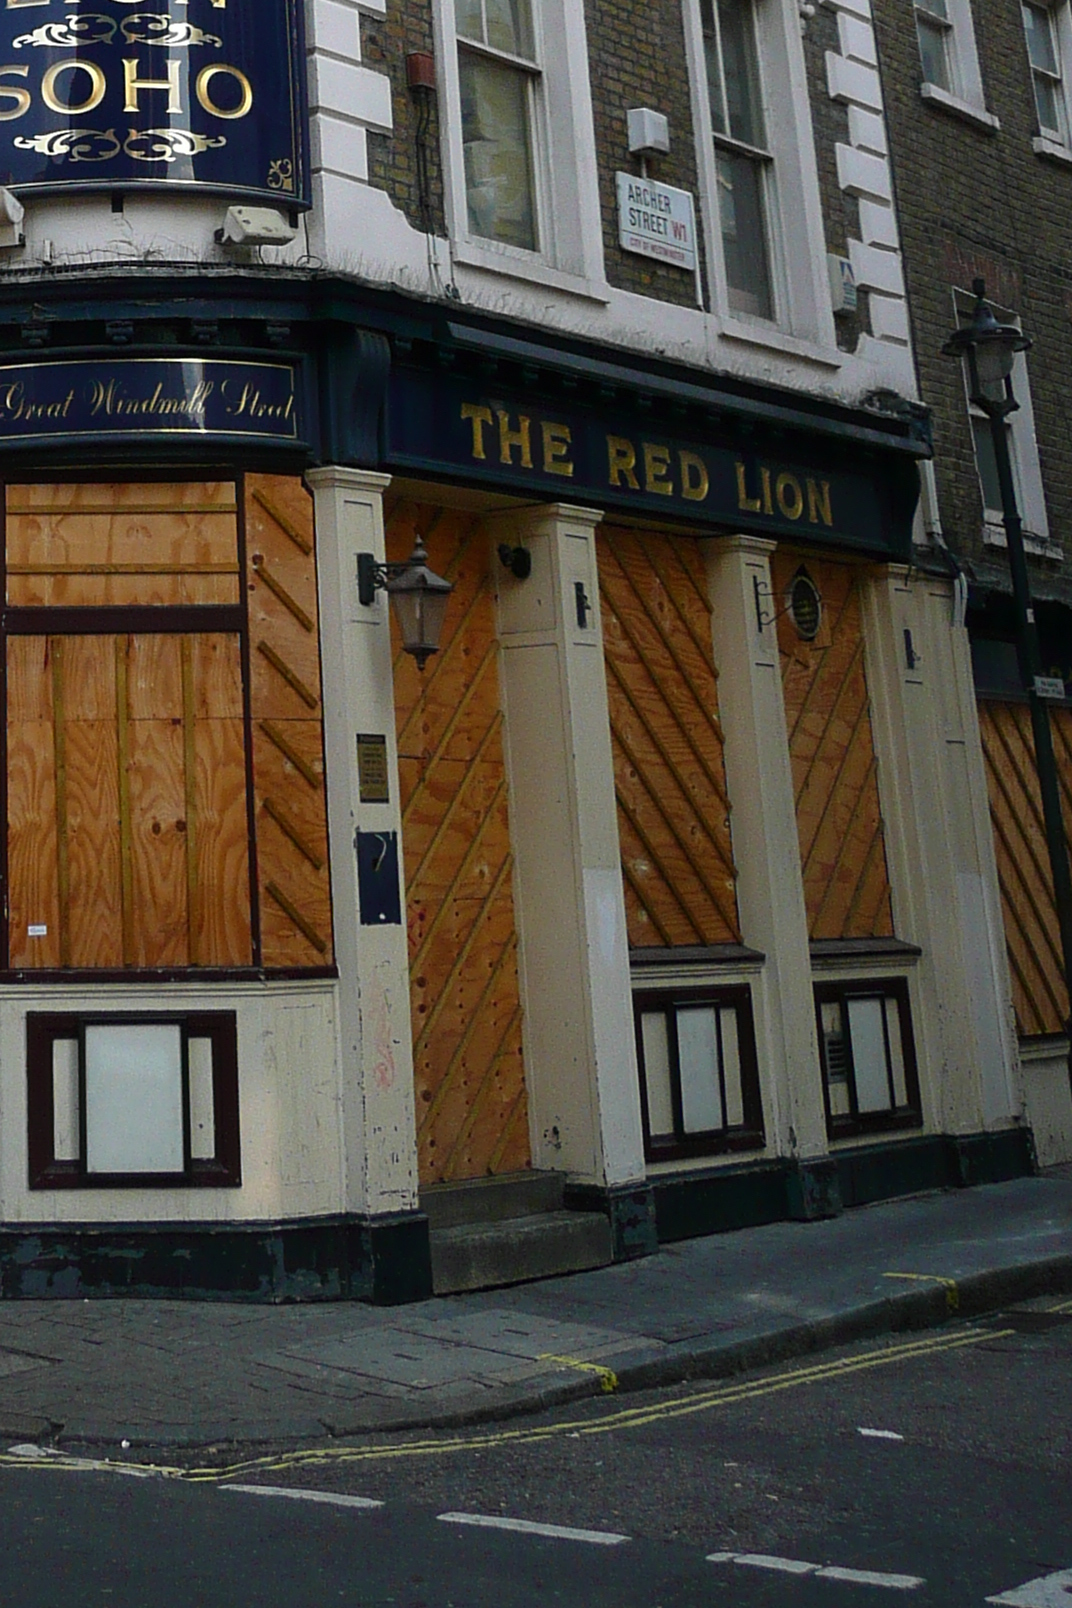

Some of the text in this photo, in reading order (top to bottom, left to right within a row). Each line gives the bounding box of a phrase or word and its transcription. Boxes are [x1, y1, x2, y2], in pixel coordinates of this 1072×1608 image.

[627, 183, 672, 214] ARCHER
[628, 207, 688, 242] STREET W1
[85, 378, 214, 415] Windmill
[221, 380, 294, 420] Street
[460, 402, 833, 526] THE RED LION
